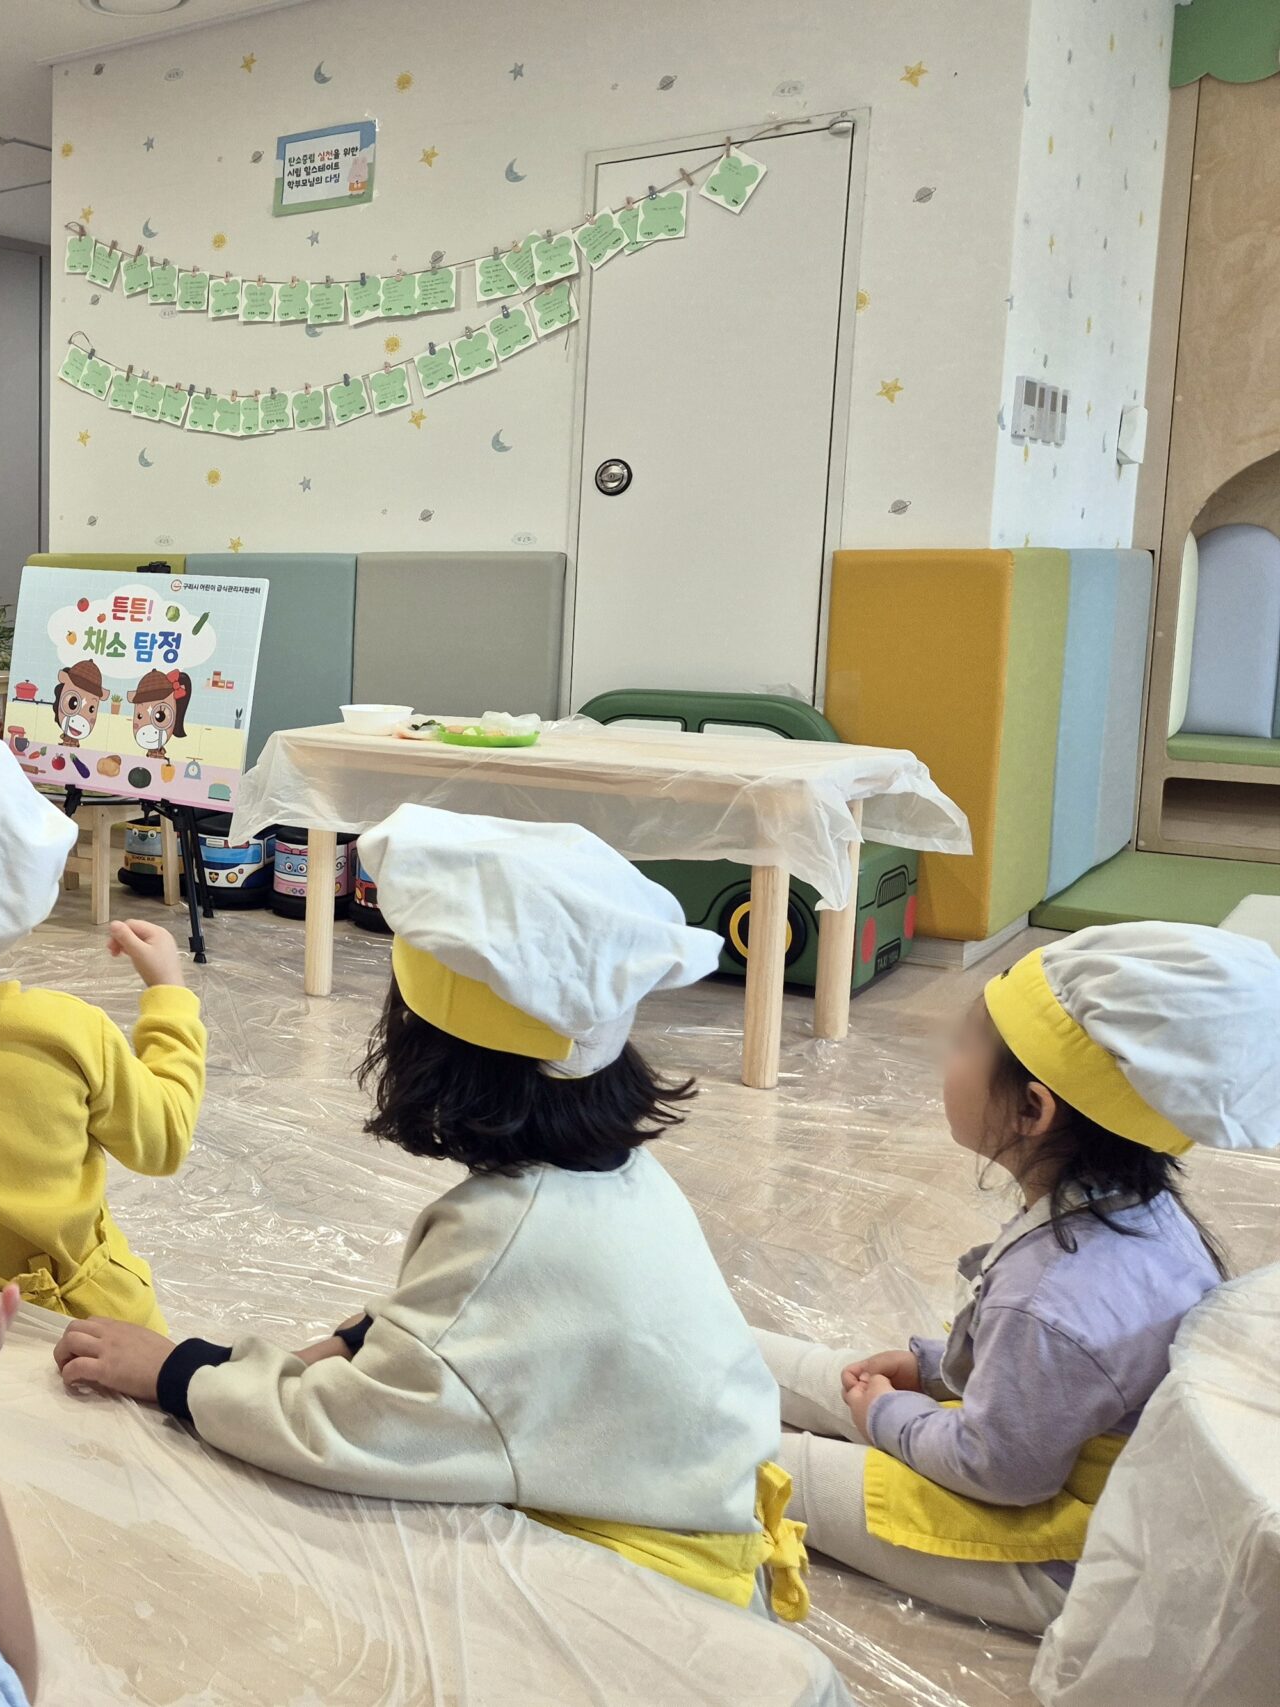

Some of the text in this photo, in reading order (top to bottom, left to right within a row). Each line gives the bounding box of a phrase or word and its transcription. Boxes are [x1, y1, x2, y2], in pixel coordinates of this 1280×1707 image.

[288, 146, 359, 167] 탄소중립 실천을 위한
[287, 161, 340, 178] 시립 힐스테이트
[287, 172, 340, 190] 학부모님의 다짐
[183, 582, 262, 594] 구리시 어린이 급식관리지원센터
[111, 596, 154, 622] 튼튼!
[83, 626, 182, 664] 채소 탐정
